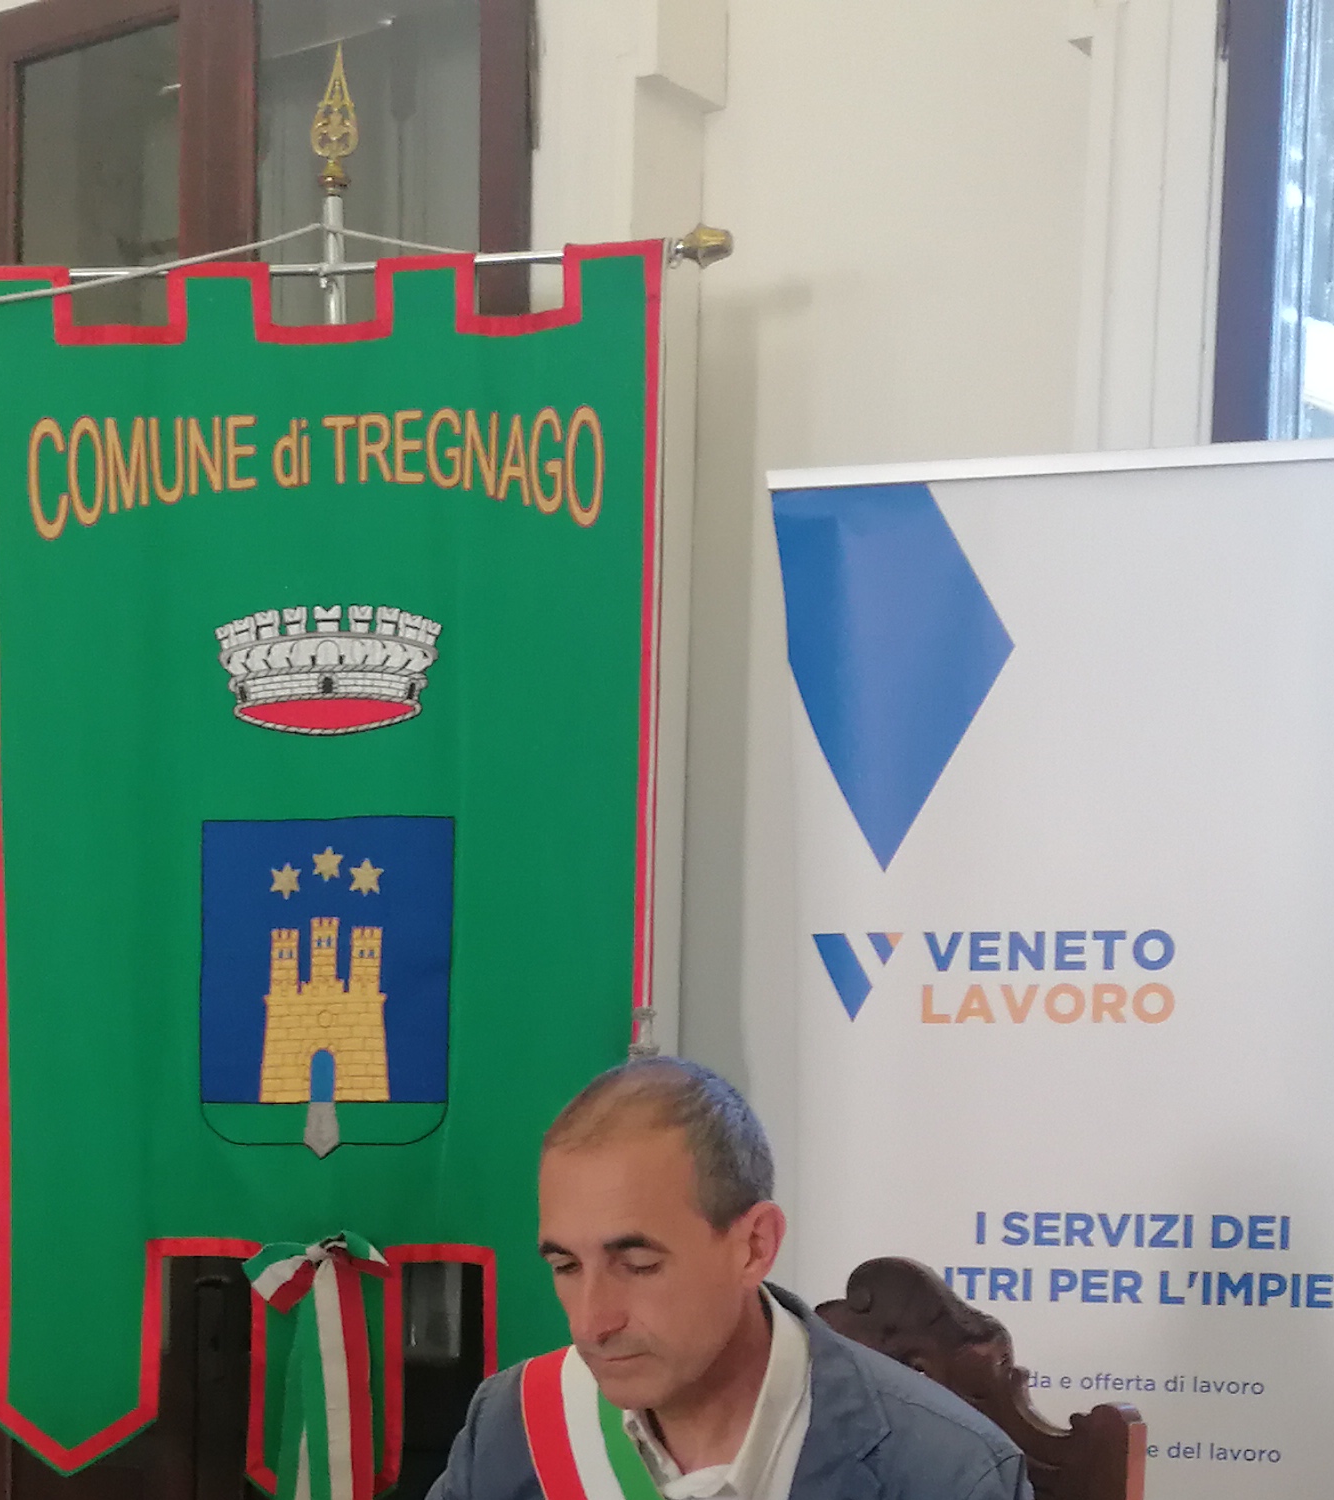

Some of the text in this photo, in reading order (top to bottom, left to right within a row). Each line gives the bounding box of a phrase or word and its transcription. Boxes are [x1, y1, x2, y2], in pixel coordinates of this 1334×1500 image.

[27, 405, 605, 541] COMUNE di TREGNAGO
[923, 928, 1176, 973] VENETO
[921, 982, 1176, 1025] LAVORO
[976, 1211, 1290, 1251] I SERVIZI DEI
[944, 1266, 1032, 1302] TRI
[1050, 1269, 1142, 1304] PER
[1060, 1376, 1072, 1390] e
[1080, 1373, 1156, 1392] offerta
[1164, 1375, 1185, 1393] di
[1193, 1376, 1266, 1395] lavoro
[1167, 1442, 1201, 1459] del
[1210, 1443, 1282, 1463] lavoro
